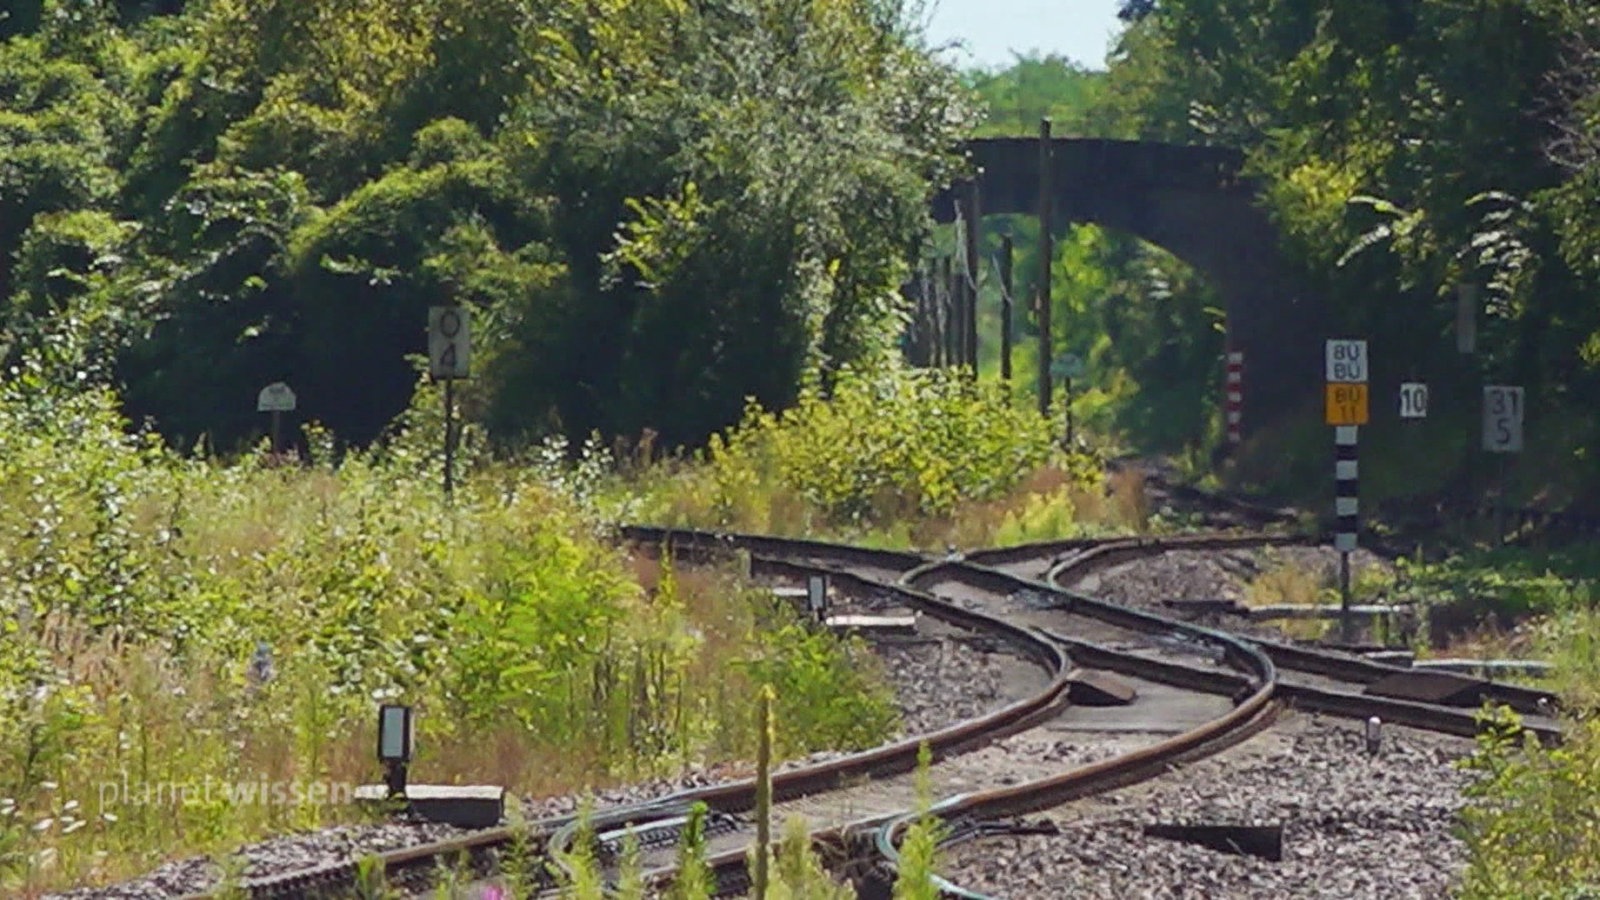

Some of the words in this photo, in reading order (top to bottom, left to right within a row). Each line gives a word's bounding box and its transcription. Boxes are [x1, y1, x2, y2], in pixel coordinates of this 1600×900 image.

[440, 342, 458, 369] 4
[1401, 389, 1426, 413] 10
[1491, 390, 1519, 415] 31
[1497, 419, 1510, 444] 5
